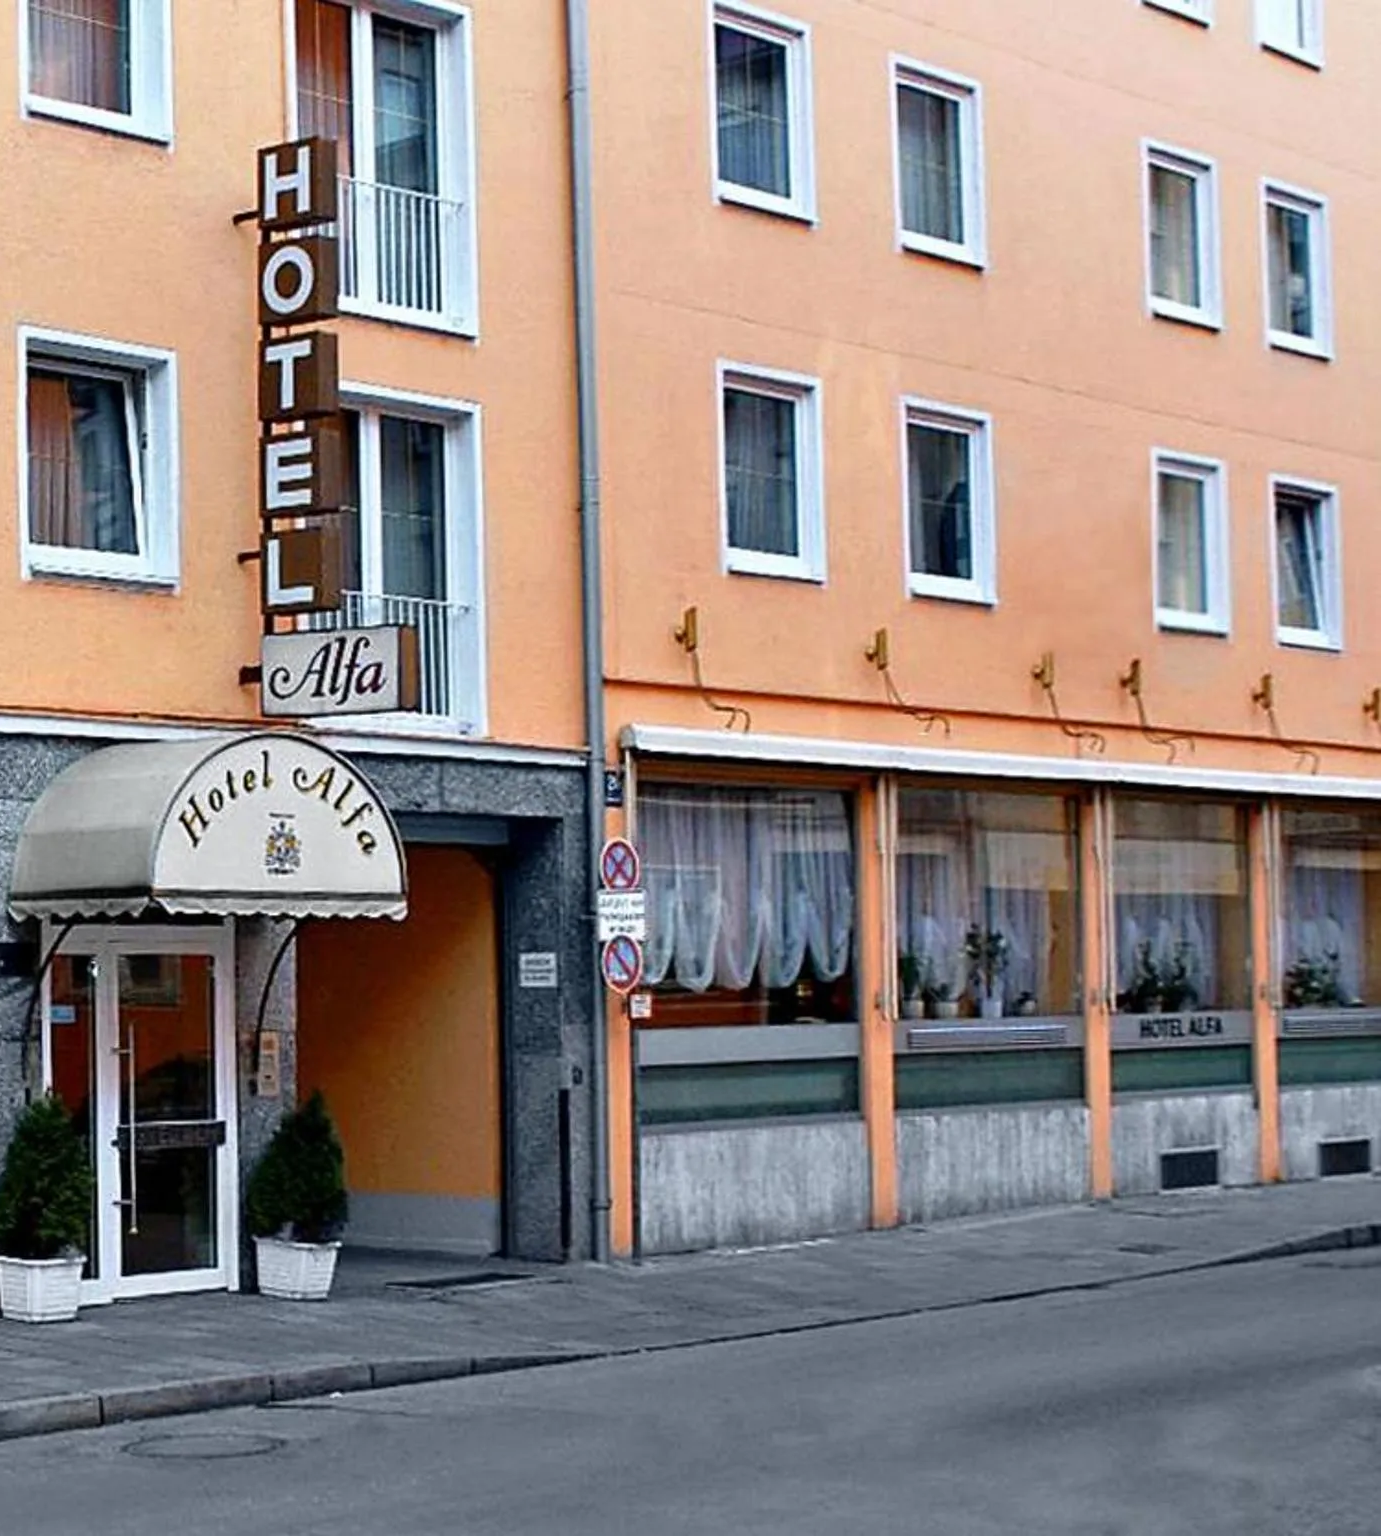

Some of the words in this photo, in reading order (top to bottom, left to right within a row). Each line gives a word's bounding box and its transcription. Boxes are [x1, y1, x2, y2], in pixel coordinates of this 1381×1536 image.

[262, 146, 315, 607] HOTEL
[268, 636, 386, 707] Alfa
[178, 750, 273, 848] Hotel
[293, 765, 378, 855] Alfa
[1139, 1018, 1186, 1038] HOTEL
[1189, 1015, 1223, 1036] ALFA
